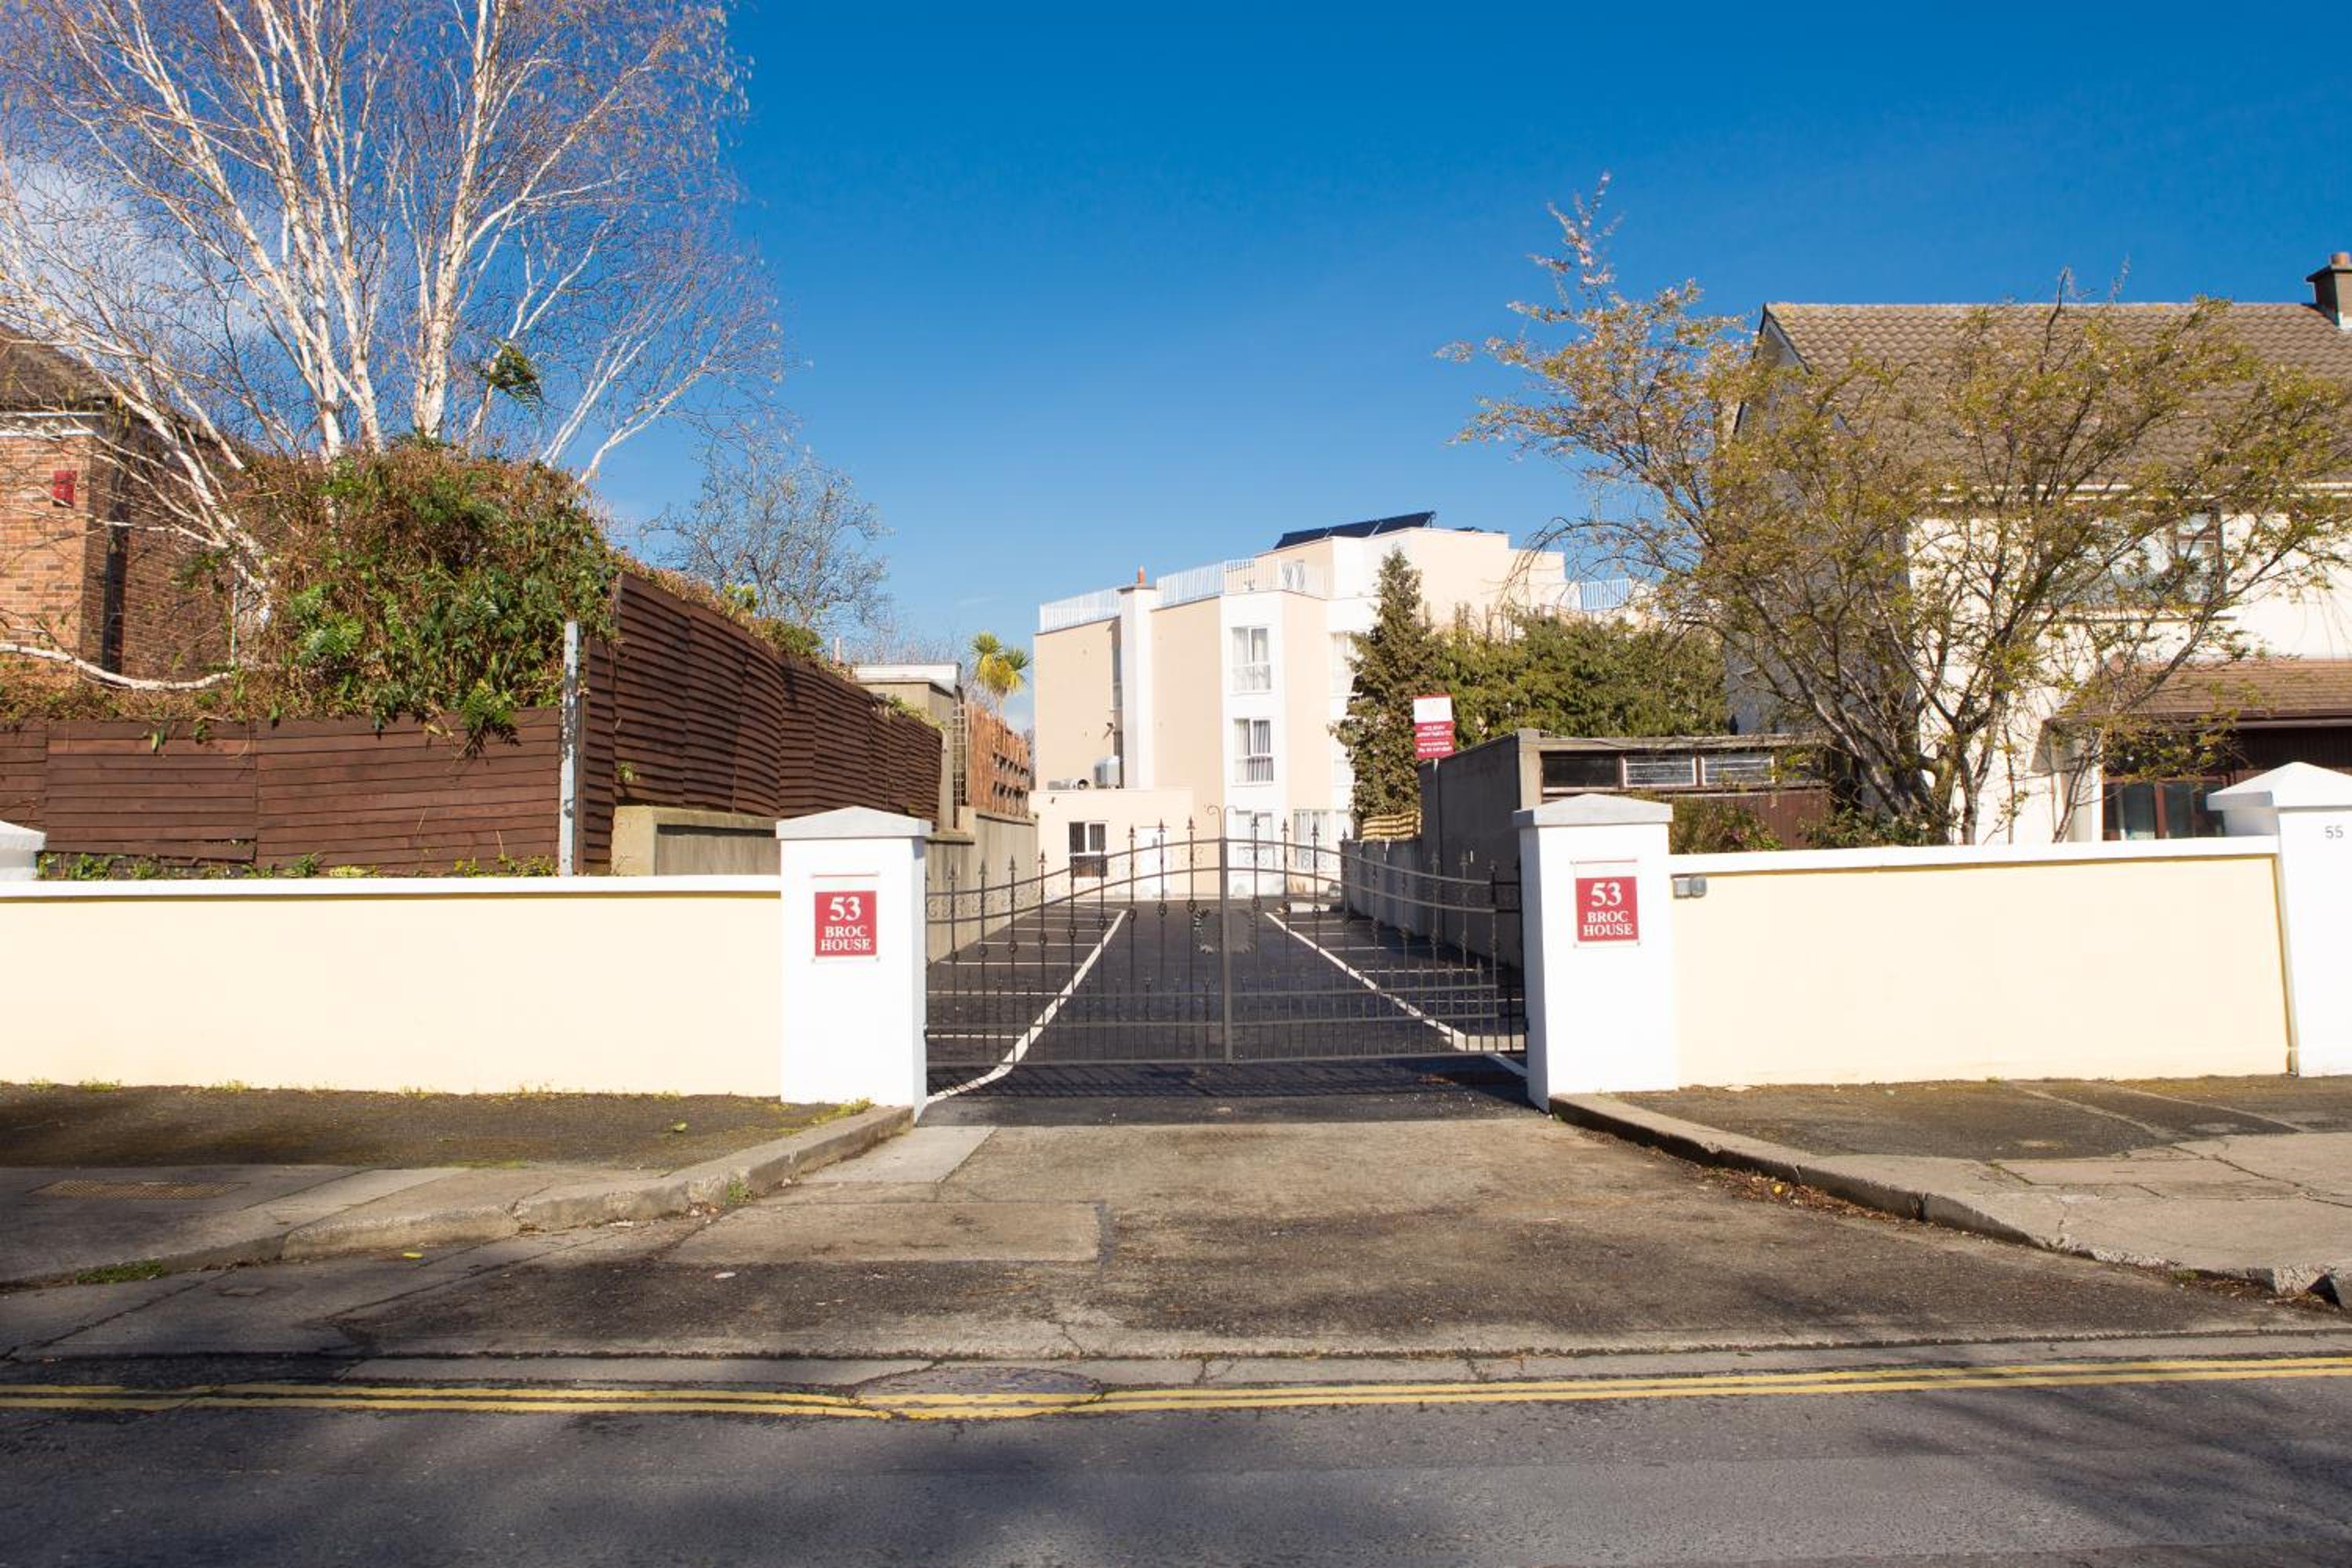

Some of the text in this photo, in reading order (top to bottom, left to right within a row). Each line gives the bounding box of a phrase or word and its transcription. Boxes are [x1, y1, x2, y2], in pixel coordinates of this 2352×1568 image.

[2325, 825, 2343, 839] 55
[1591, 881, 1622, 907] 53
[829, 896, 861, 921] 53
[1587, 910, 1629, 923] BROC
[824, 924, 867, 938] BROC
[1583, 923, 1634, 937] HOUSE
[820, 938, 872, 951] HOUSE
